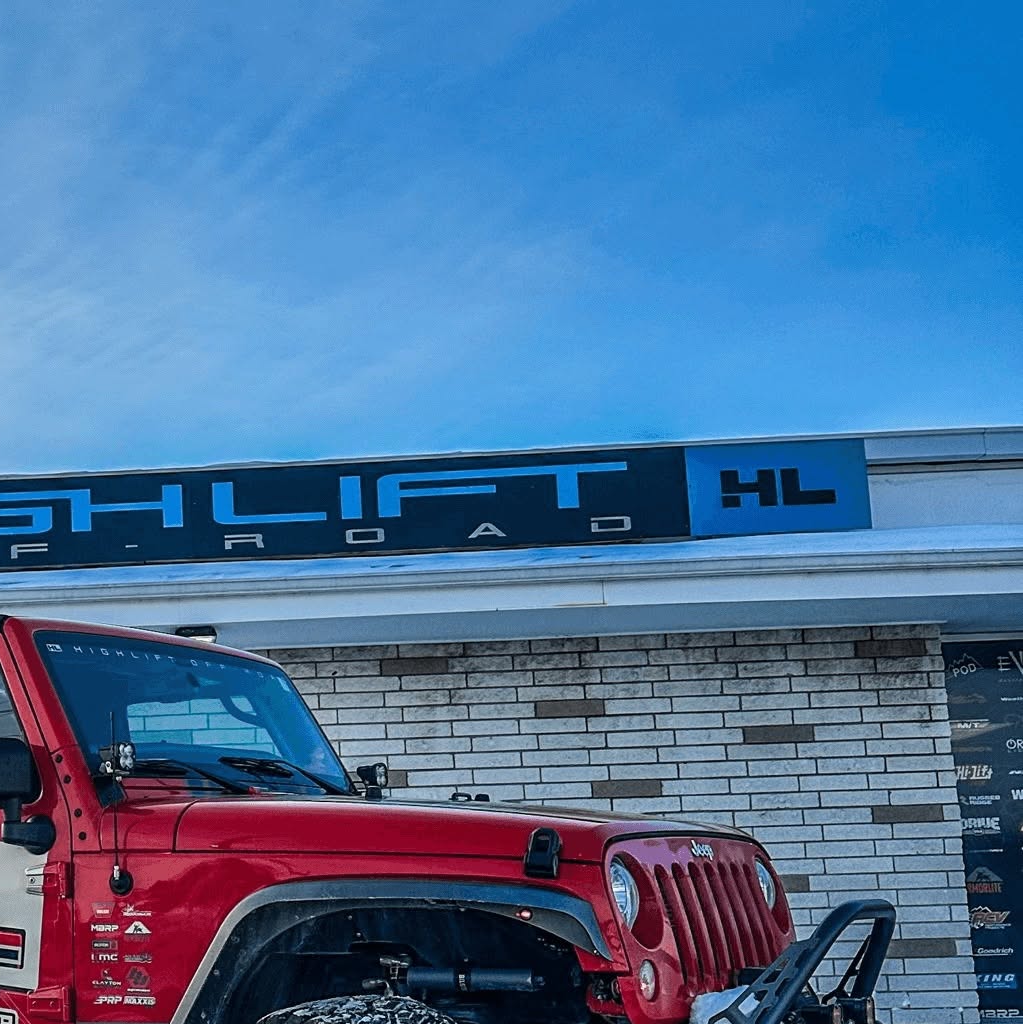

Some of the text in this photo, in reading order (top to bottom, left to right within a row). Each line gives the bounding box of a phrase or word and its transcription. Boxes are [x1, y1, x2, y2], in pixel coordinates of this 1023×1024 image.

[720, 467, 836, 508] HL
[73, 645, 176, 663] HIGHLIFT
[691, 839, 714, 861] Jeep
[91, 923, 119, 932] MBRP
